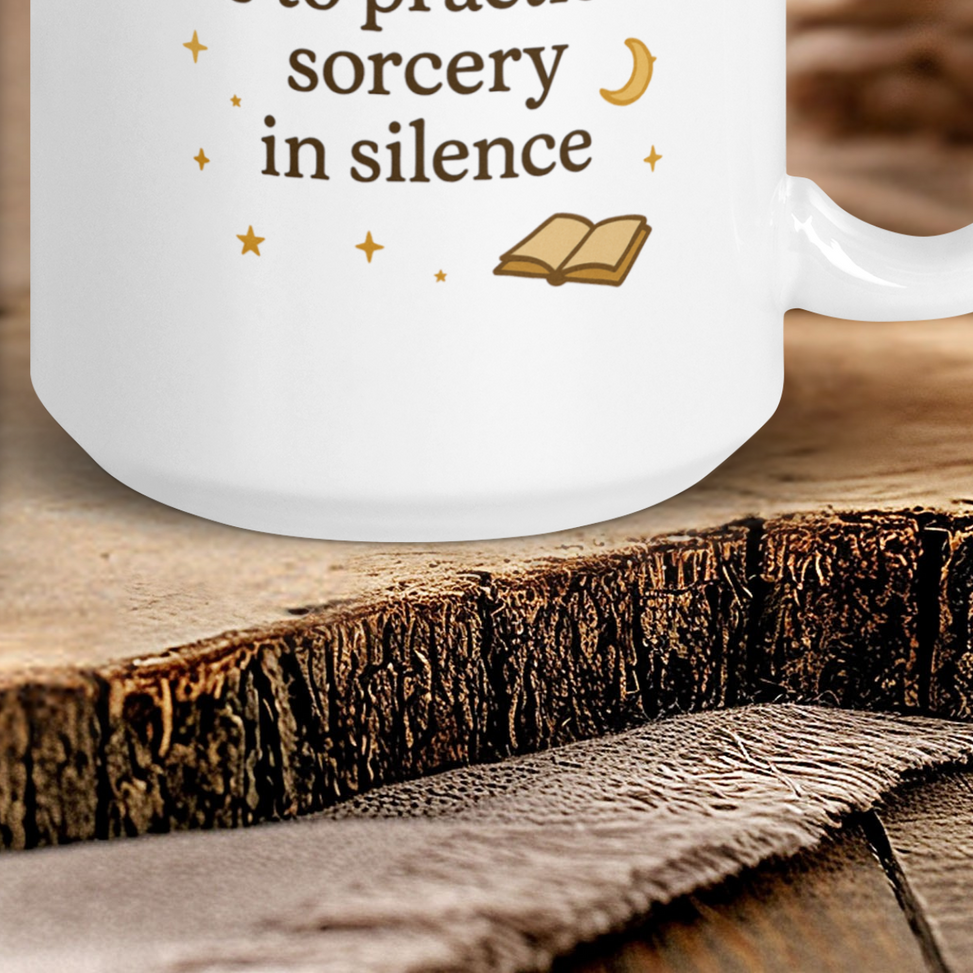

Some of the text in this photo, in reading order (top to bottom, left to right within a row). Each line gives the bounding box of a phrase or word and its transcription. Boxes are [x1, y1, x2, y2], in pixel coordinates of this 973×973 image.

[287, 44, 569, 110] sorcery
[261, 114, 592, 183] in silence
